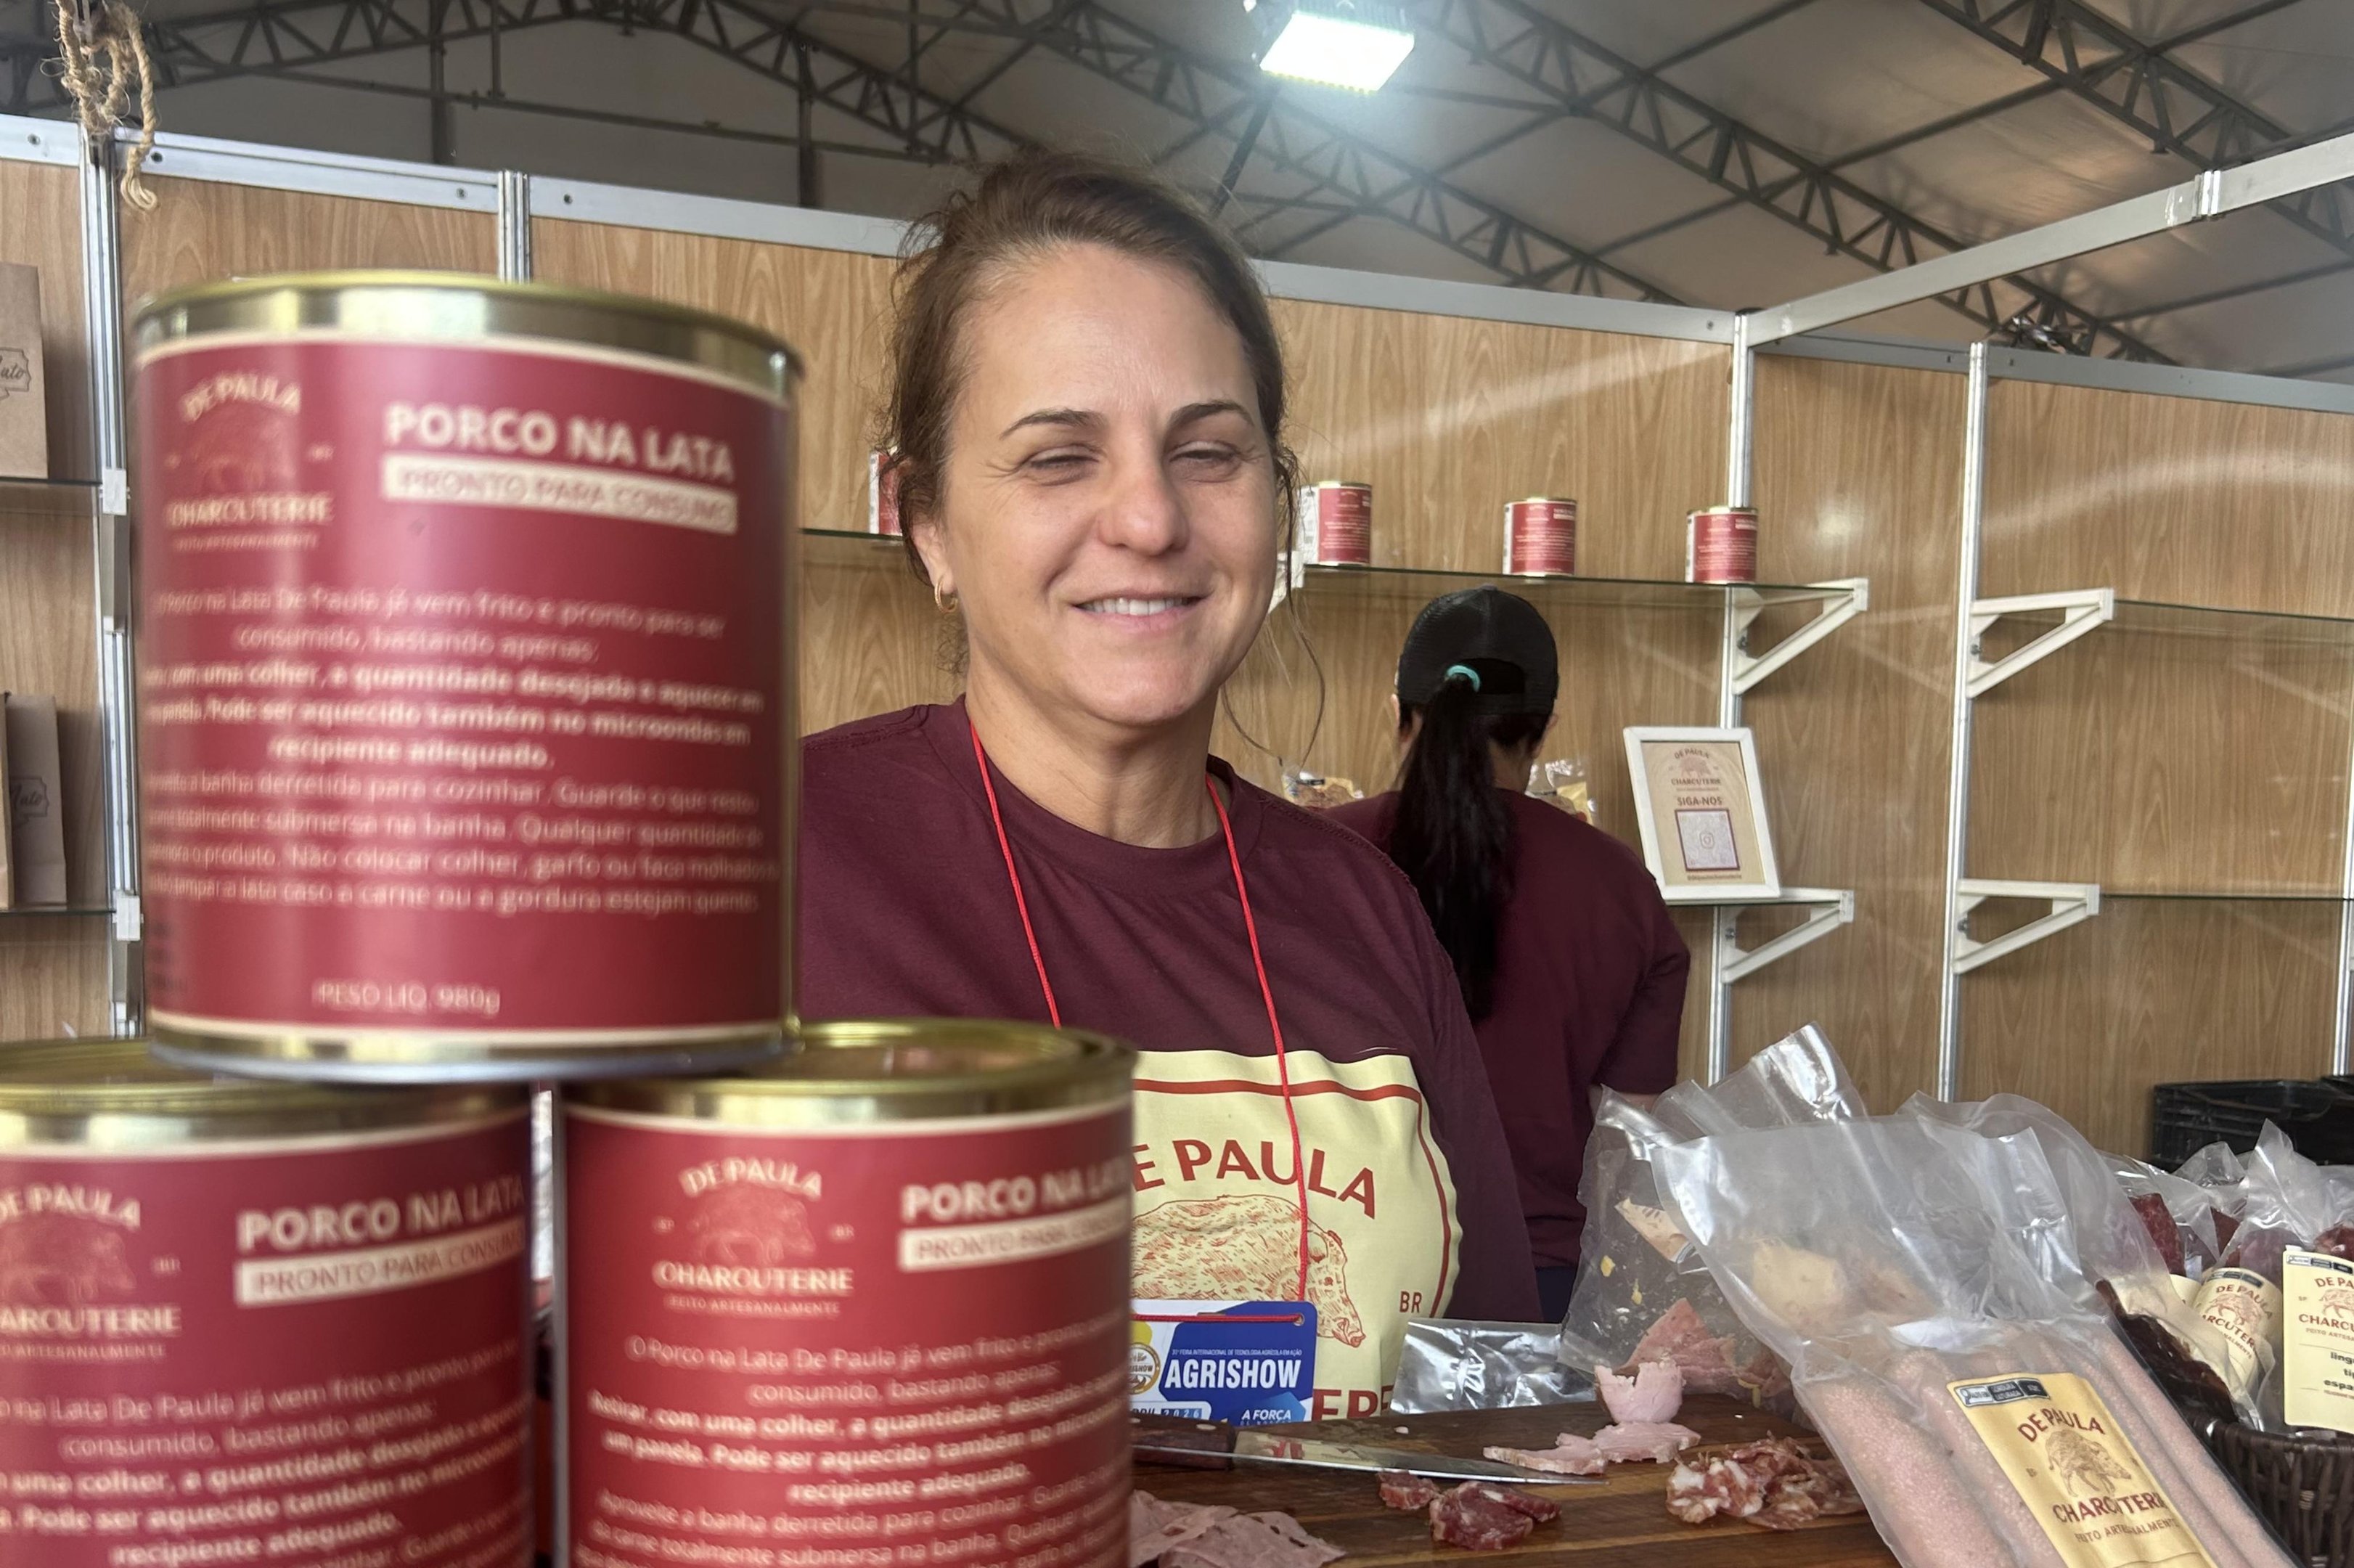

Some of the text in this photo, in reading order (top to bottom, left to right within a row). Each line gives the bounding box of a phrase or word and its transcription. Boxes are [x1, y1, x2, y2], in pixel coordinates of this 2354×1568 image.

[217, 373, 301, 415] PAULA
[384, 401, 735, 481] PORCO NA LATA
[679, 1156, 822, 1201] DE PAULA
[1172, 1140, 1376, 1220] PAULA
[25, 1183, 141, 1230] PAULA
[901, 1177, 1037, 1223] PORCO
[237, 1200, 400, 1252] PORCO
[406, 1188, 463, 1230] NA
[918, 1232, 1014, 1259] PRONTO
[259, 1261, 377, 1294] PRONTO
[384, 1252, 444, 1279] PARA
[655, 1261, 855, 1297] CHARCUTERIE
[2314, 1277, 2334, 1287] DE
[711, 1299, 840, 1319] ARTESANALMENTE
[1400, 1291, 1423, 1314] BR
[2216, 1284, 2273, 1320] DE PAULA
[0, 1306, 181, 1337] ARCUTERIE
[740, 1347, 788, 1373] Lata
[830, 1348, 896, 1374] Paula
[1164, 1358, 1301, 1389] AGRISHOW
[703, 1414, 756, 1440] uma
[870, 1402, 1004, 1440] quantidade
[1253, 1409, 1291, 1421] FORÇA
[2018, 1408, 2106, 1443] DE PAULA
[817, 1444, 931, 1476] aquecido
[788, 1478, 915, 1509] recipiente
